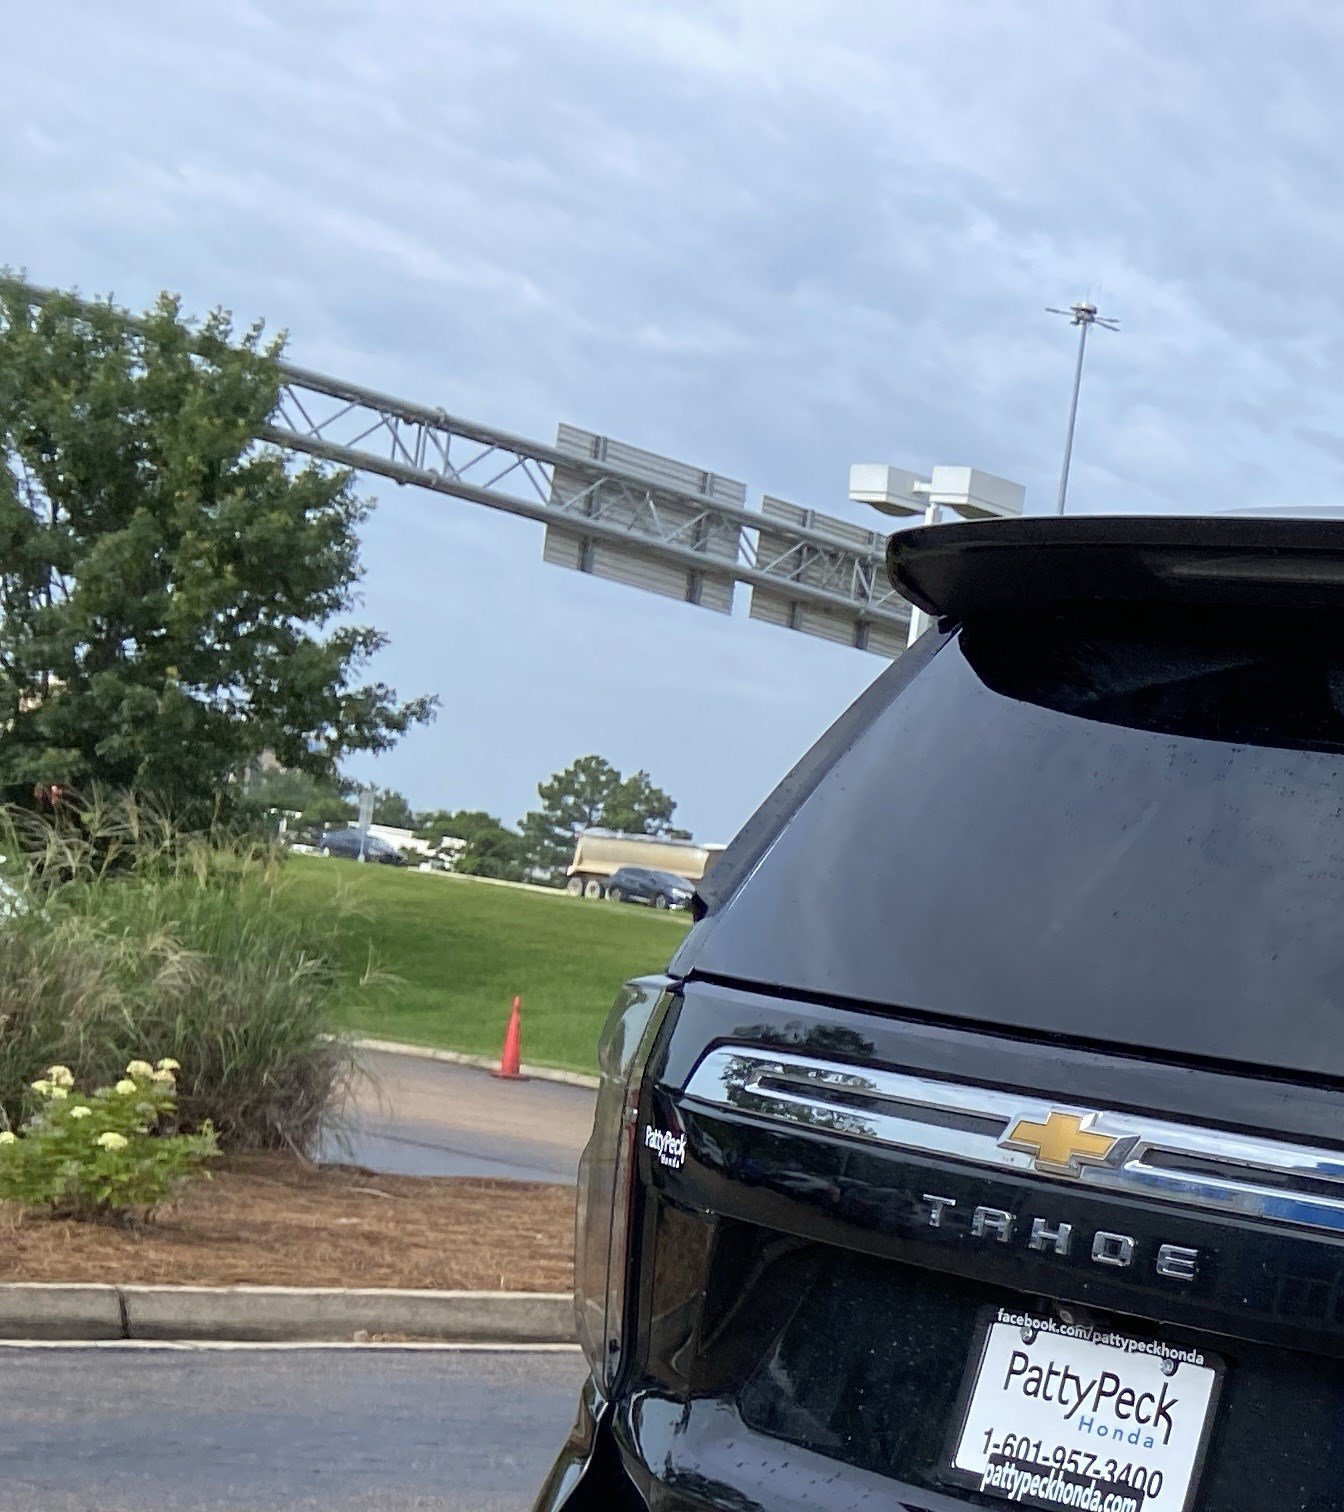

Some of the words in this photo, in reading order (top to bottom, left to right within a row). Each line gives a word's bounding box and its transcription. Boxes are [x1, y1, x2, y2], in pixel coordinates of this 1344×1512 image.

[645, 1125, 686, 1164] PattyPeck
[923, 1193, 1199, 1282] TAHOE
[997, 1308, 1205, 1365] facebook.com/pattypeckhonda
[1003, 1351, 1180, 1445] PattyPeck
[983, 1428, 1164, 1499] 1-601-957-3400
[1078, 1415, 1155, 1449] Honda
